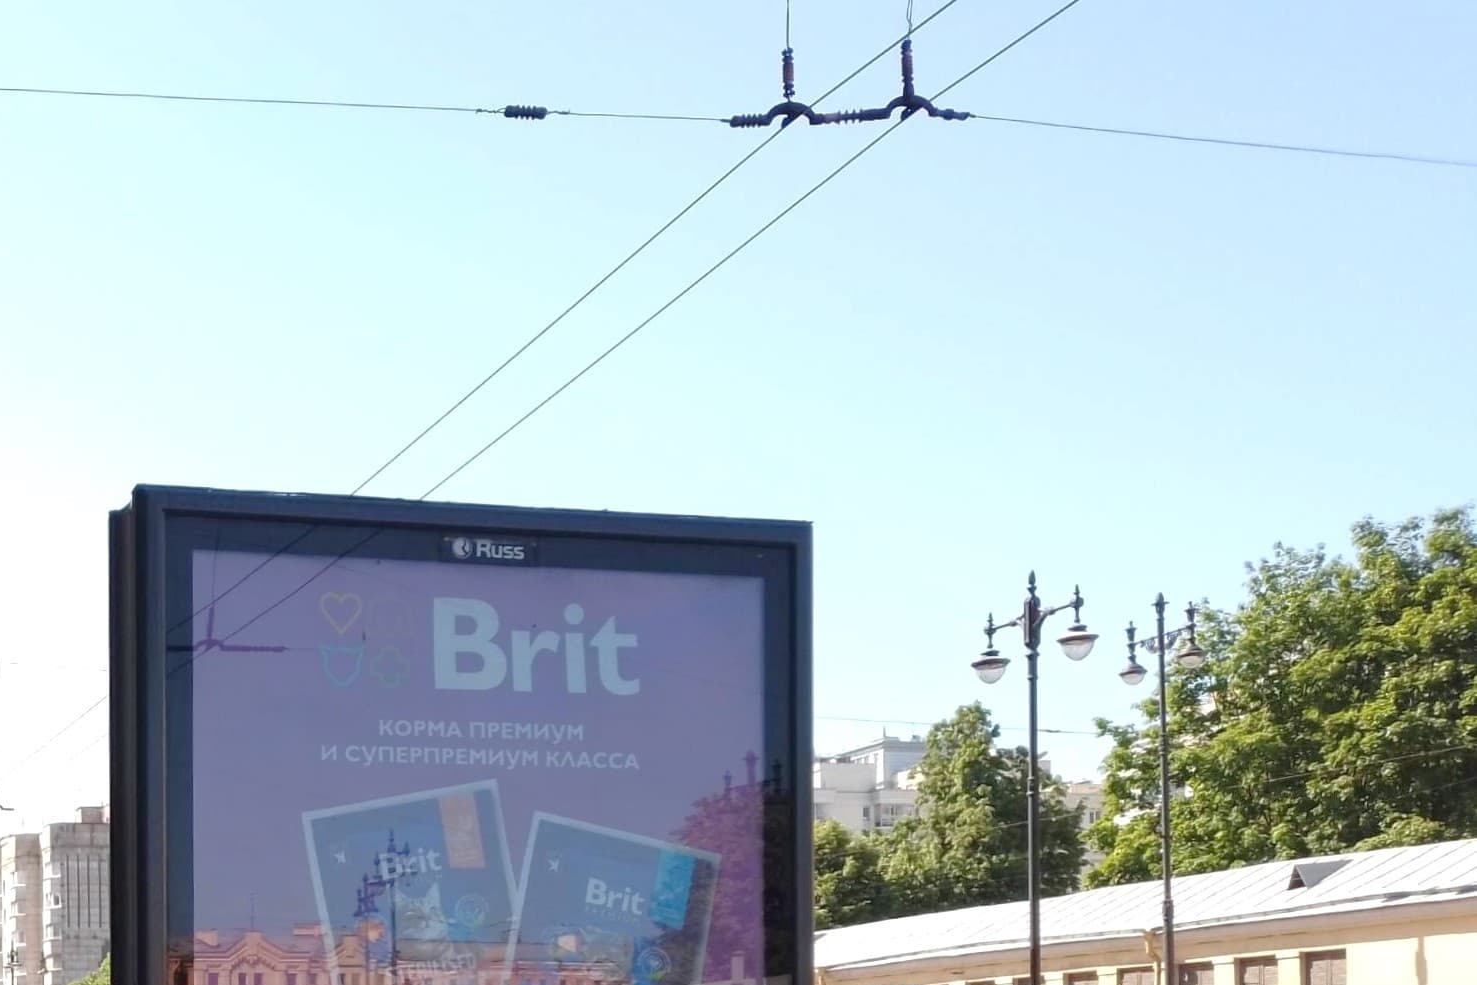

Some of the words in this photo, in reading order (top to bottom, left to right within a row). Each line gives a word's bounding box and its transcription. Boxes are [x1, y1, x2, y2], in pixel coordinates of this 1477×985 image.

[475, 539, 525, 559] Russ
[433, 597, 640, 696] Brit
[378, 718, 463, 738] КОРМА
[469, 721, 584, 744] ПРЕМИУМ
[321, 745, 337, 761] И
[345, 746, 538, 770] СУПЕРПРЕМИУМ
[546, 750, 640, 770] КЛАССА
[379, 848, 442, 880] Brit
[585, 877, 645, 915] Brit
